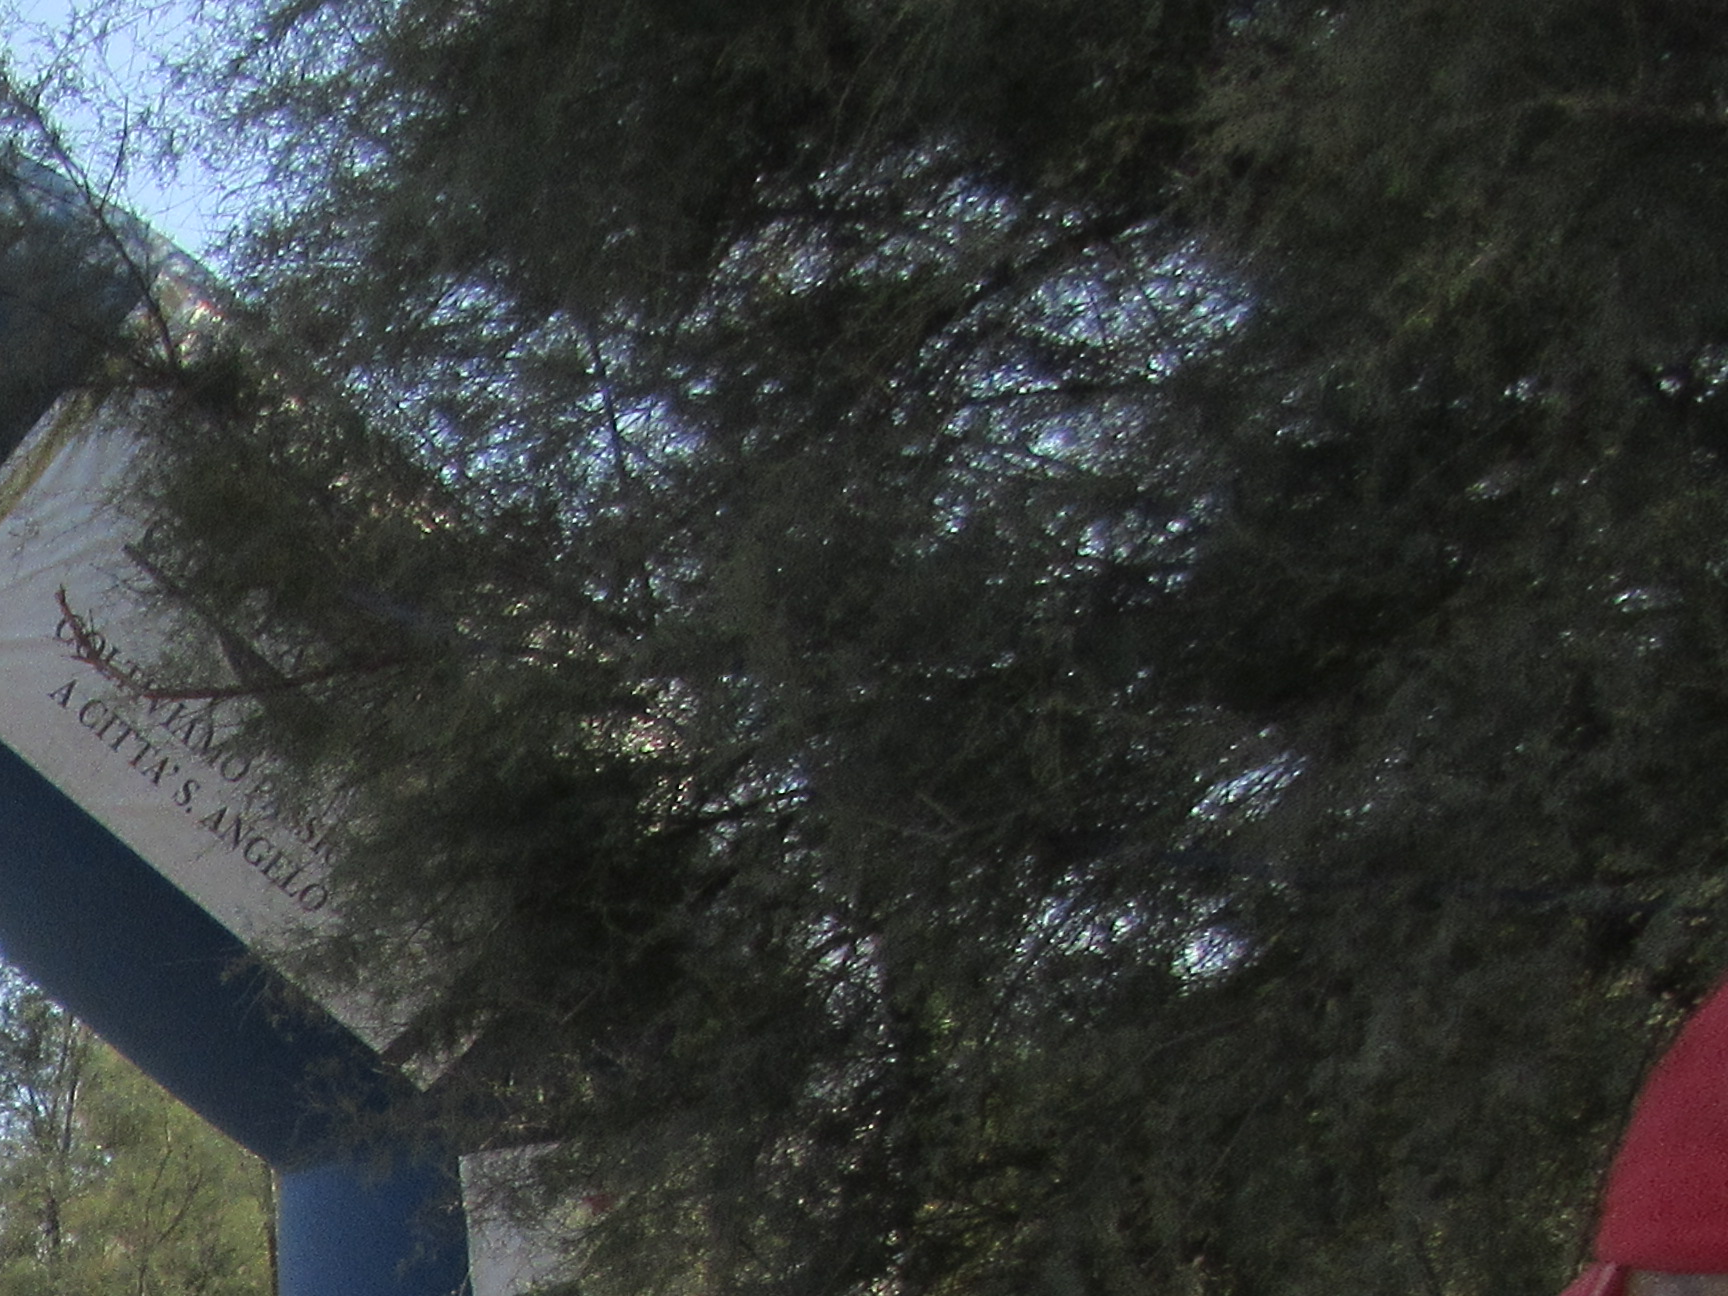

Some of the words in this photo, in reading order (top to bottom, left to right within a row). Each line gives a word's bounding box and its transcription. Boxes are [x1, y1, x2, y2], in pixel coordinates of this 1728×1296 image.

[47, 679, 77, 708] A
[78, 698, 180, 786] CITTA'
[172, 778, 200, 813] S.
[199, 805, 328, 912] ANGELO
